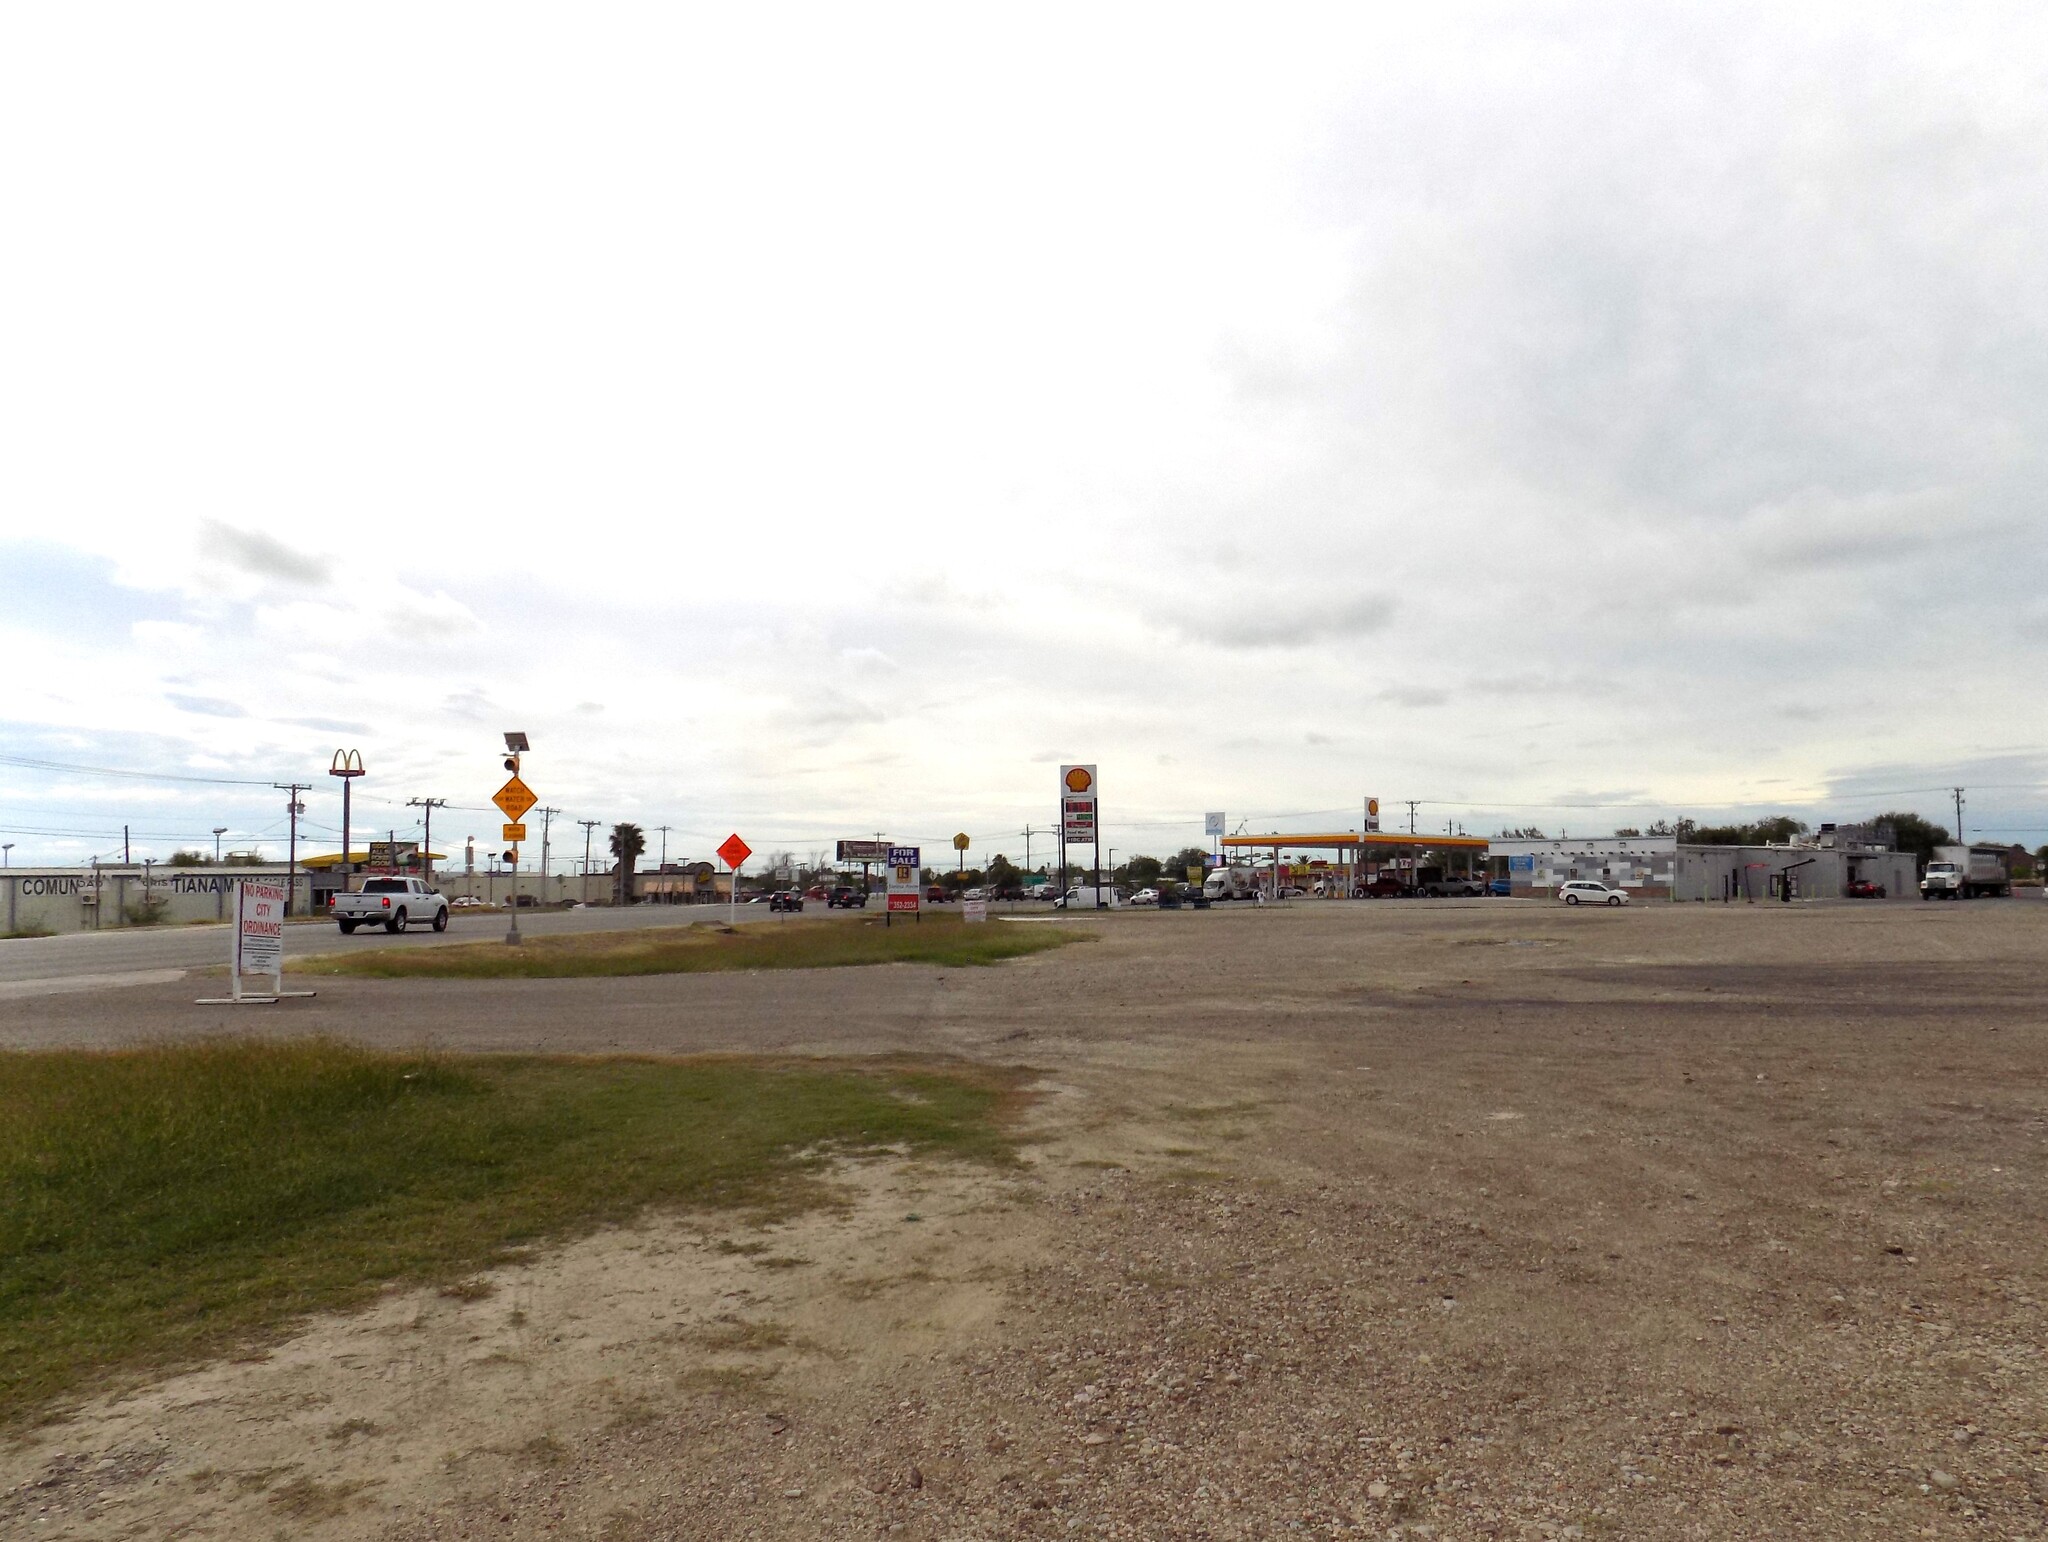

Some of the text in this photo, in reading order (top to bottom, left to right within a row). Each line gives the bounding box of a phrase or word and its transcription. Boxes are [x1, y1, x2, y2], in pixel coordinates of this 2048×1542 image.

[893, 848, 914, 857] FOR
[890, 857, 917, 865] SALE
[245, 883, 254, 897] NO
[255, 885, 285, 901] PARKING
[256, 903, 271, 917] CITY
[243, 920, 282, 936] ORDINANCE
